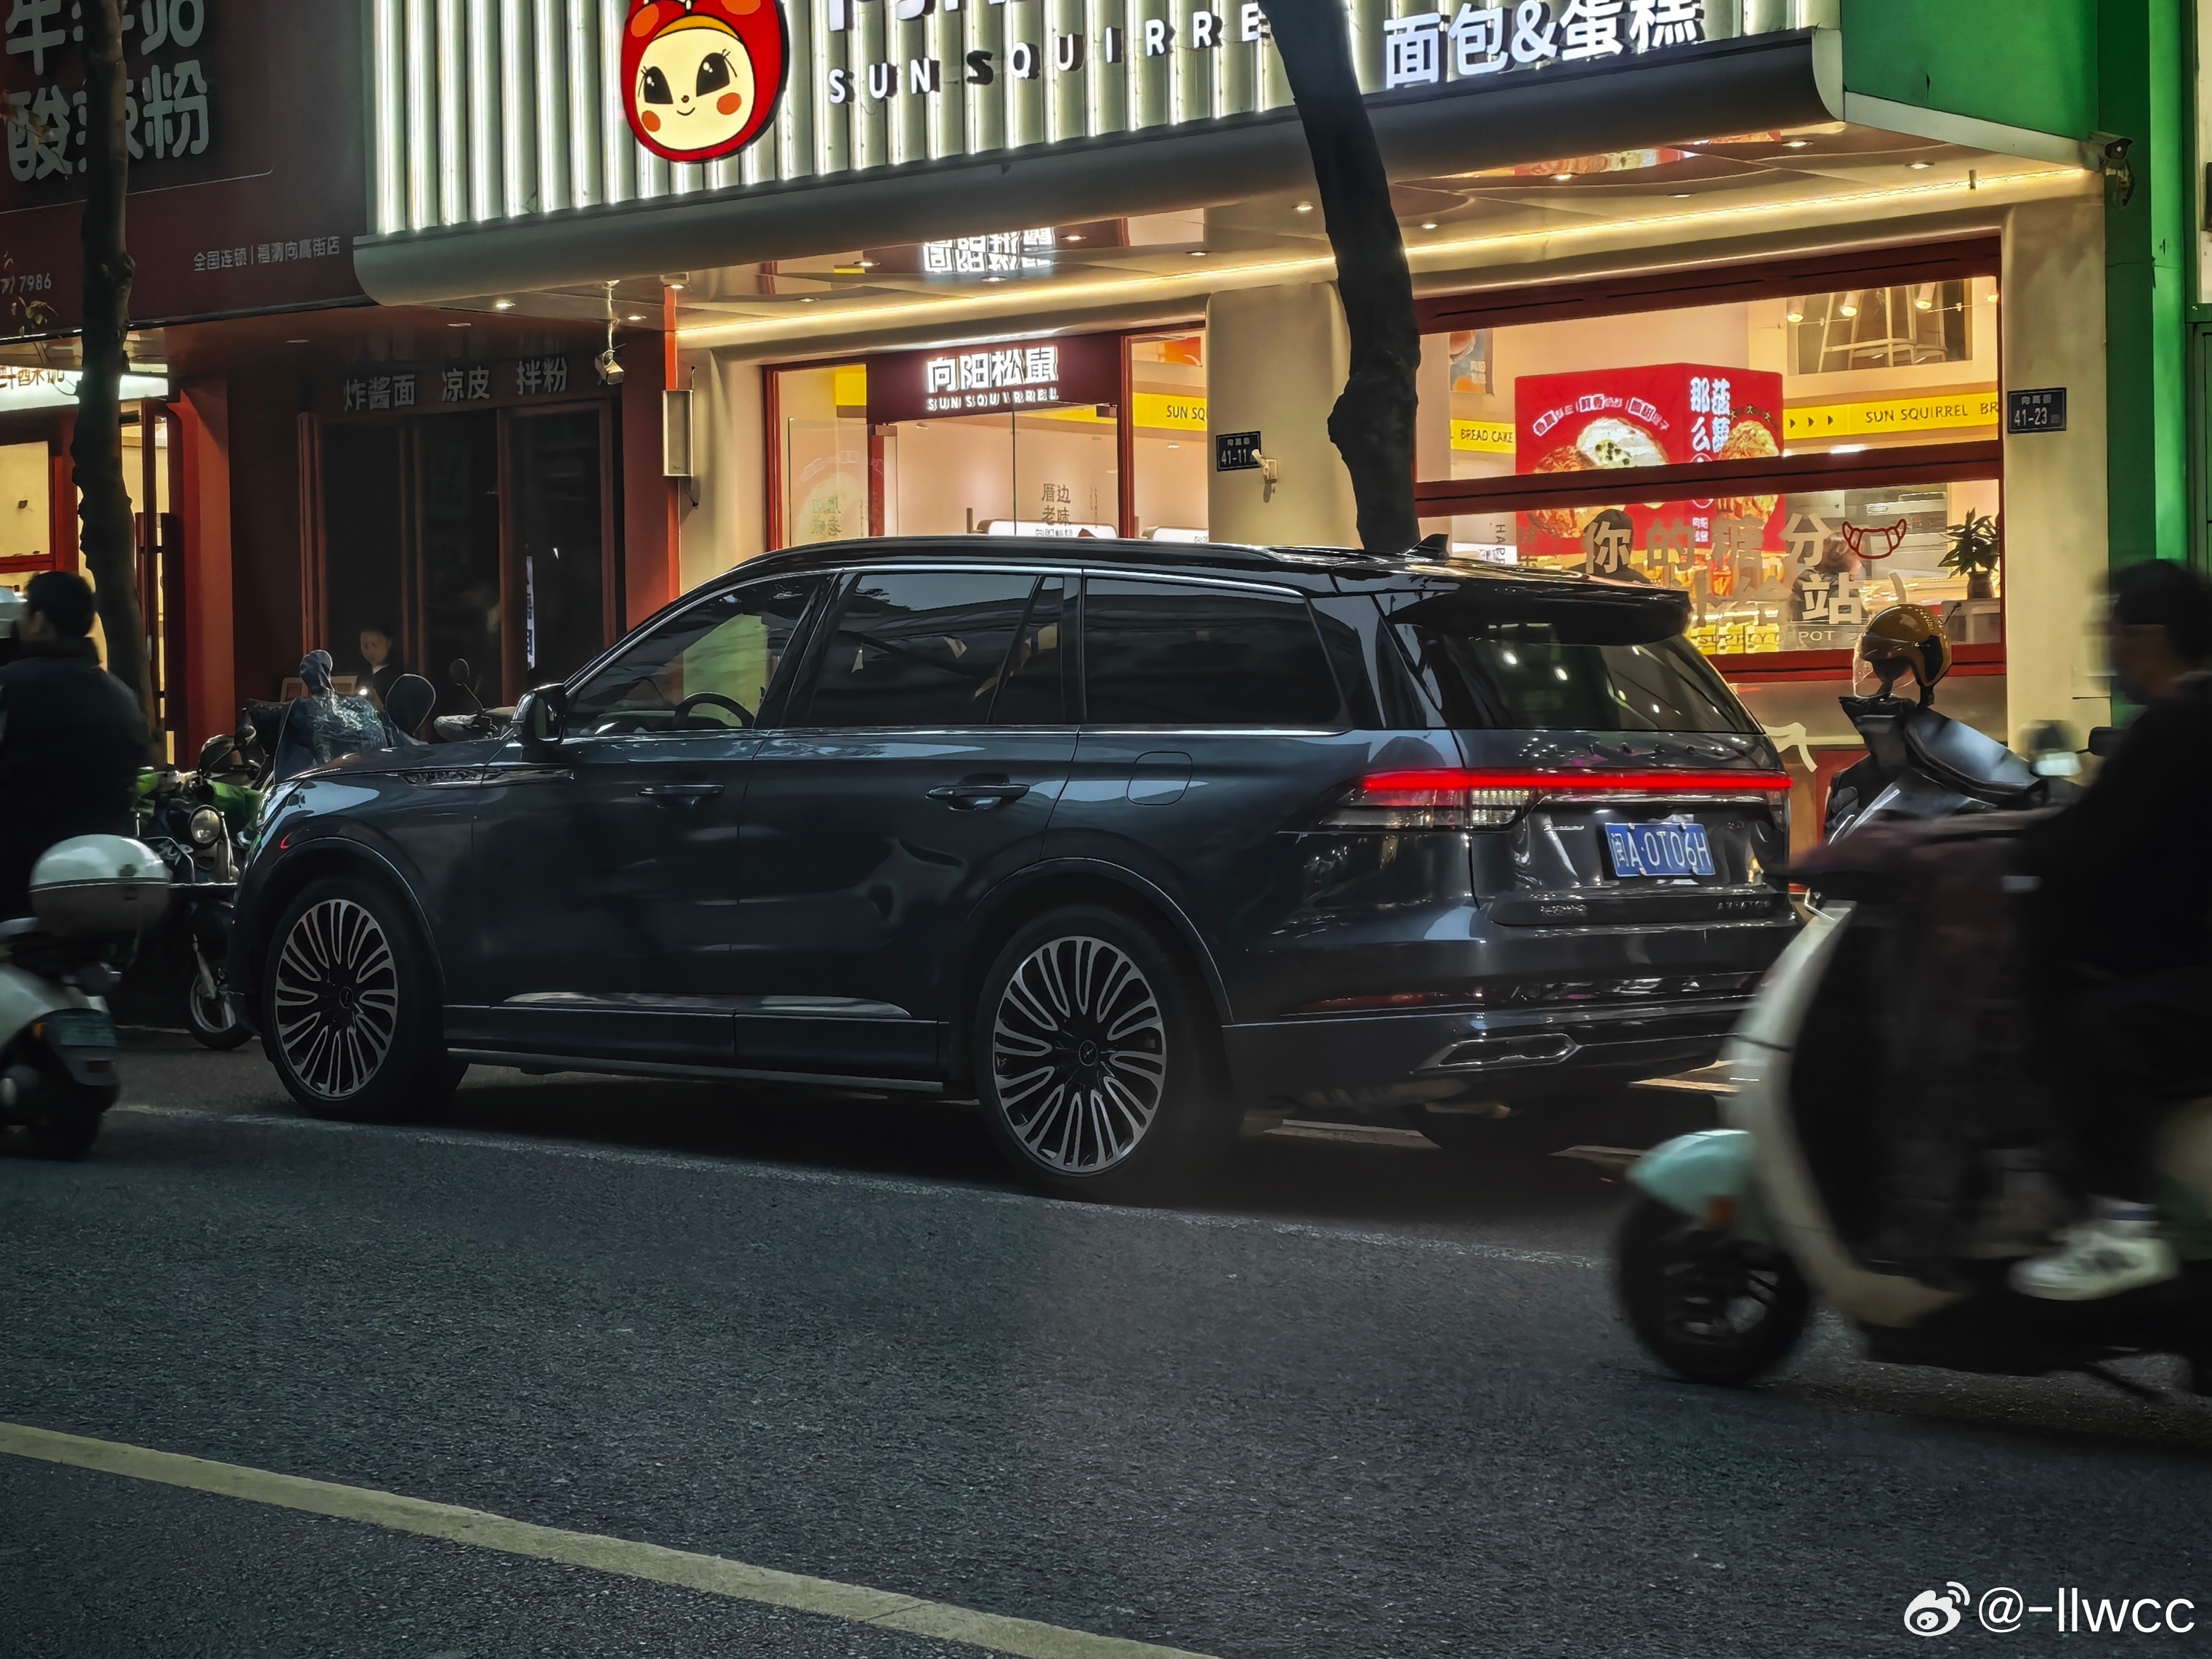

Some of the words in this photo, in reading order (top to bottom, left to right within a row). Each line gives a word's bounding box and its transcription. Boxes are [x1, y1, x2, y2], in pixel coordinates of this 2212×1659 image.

[828, 57, 933, 104] SUN
[19, 272, 52, 292] 7986
[927, 346, 1059, 393] 向阳松鼠
[343, 374, 416, 411] 炸酱面
[442, 366, 491, 401] 凉皮
[516, 357, 568, 395] 拌粉
[927, 397, 961, 411] SUN
[966, 387, 1059, 408] SQUIRREL
[1166, 405, 1188, 419] SUN
[1865, 410, 1894, 424] SUN
[1900, 403, 1969, 421] SQUIRREL
[2014, 407, 2048, 427] 41-23
[1460, 428, 1488, 441] BREAD
[1491, 430, 1513, 443] CAKE
[1221, 448, 1248, 465] 41-11
[1582, 512, 1833, 574] 你的糖分
